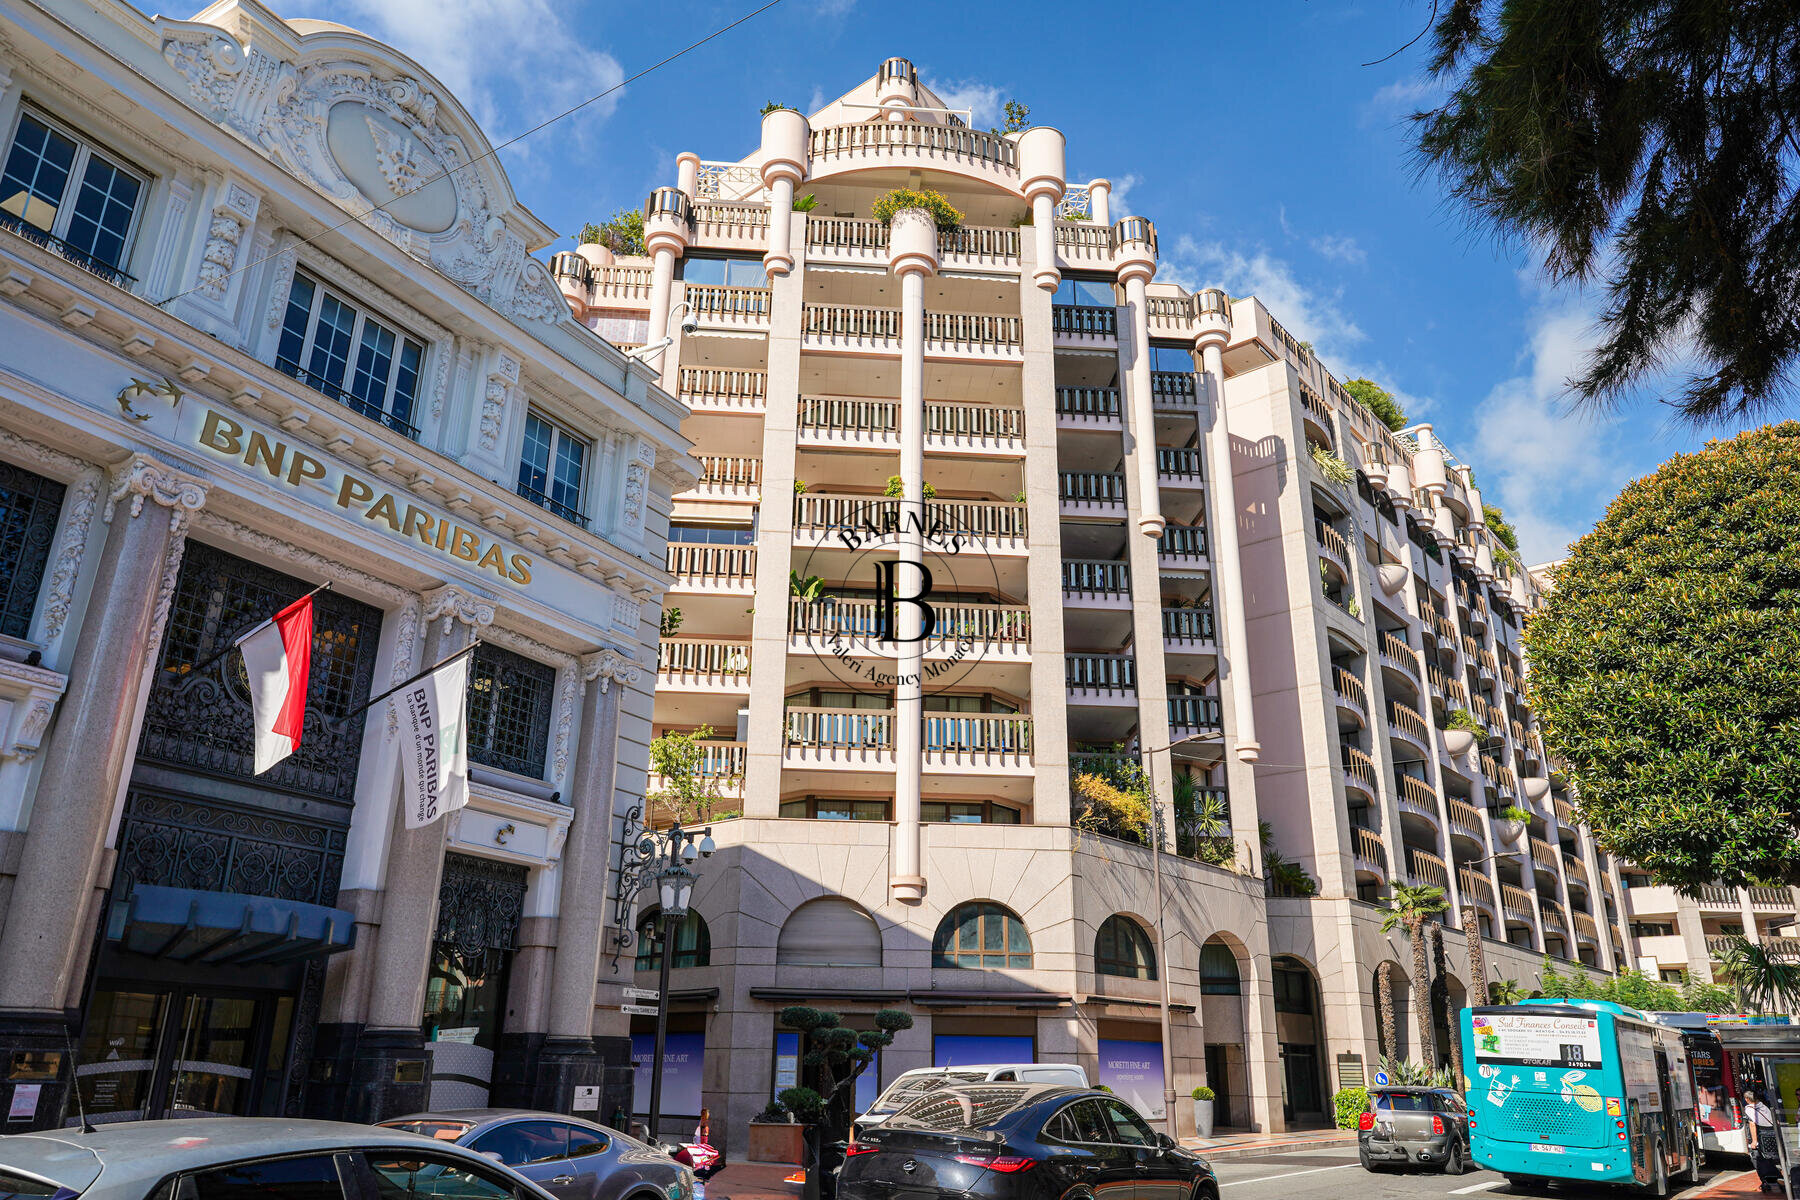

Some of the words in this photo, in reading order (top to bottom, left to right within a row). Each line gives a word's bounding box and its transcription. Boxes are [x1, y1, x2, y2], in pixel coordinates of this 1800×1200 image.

[199, 409, 327, 487] BNP
[336, 474, 533, 585] PARIBAS
[406, 694, 412, 703] La
[409, 704, 419, 733] banque
[416, 751, 424, 780] monde
[413, 688, 432, 728] BNP
[423, 733, 438, 819] PARIBAS
[1498, 1017, 1514, 1028] Sud
[1516, 1017, 1551, 1029] Finances
[1553, 1018, 1586, 1030] Conseils
[677, 1054, 689, 1063] ART
[1566, 1045, 1582, 1061] 18
[1108, 1061, 1129, 1069] MORETTI
[1130, 1062, 1141, 1070] FINE
[1142, 1062, 1151, 1070] ART
[1522, 1058, 1552, 1066] OTOKAR
[1481, 1065, 1491, 1076] 70
